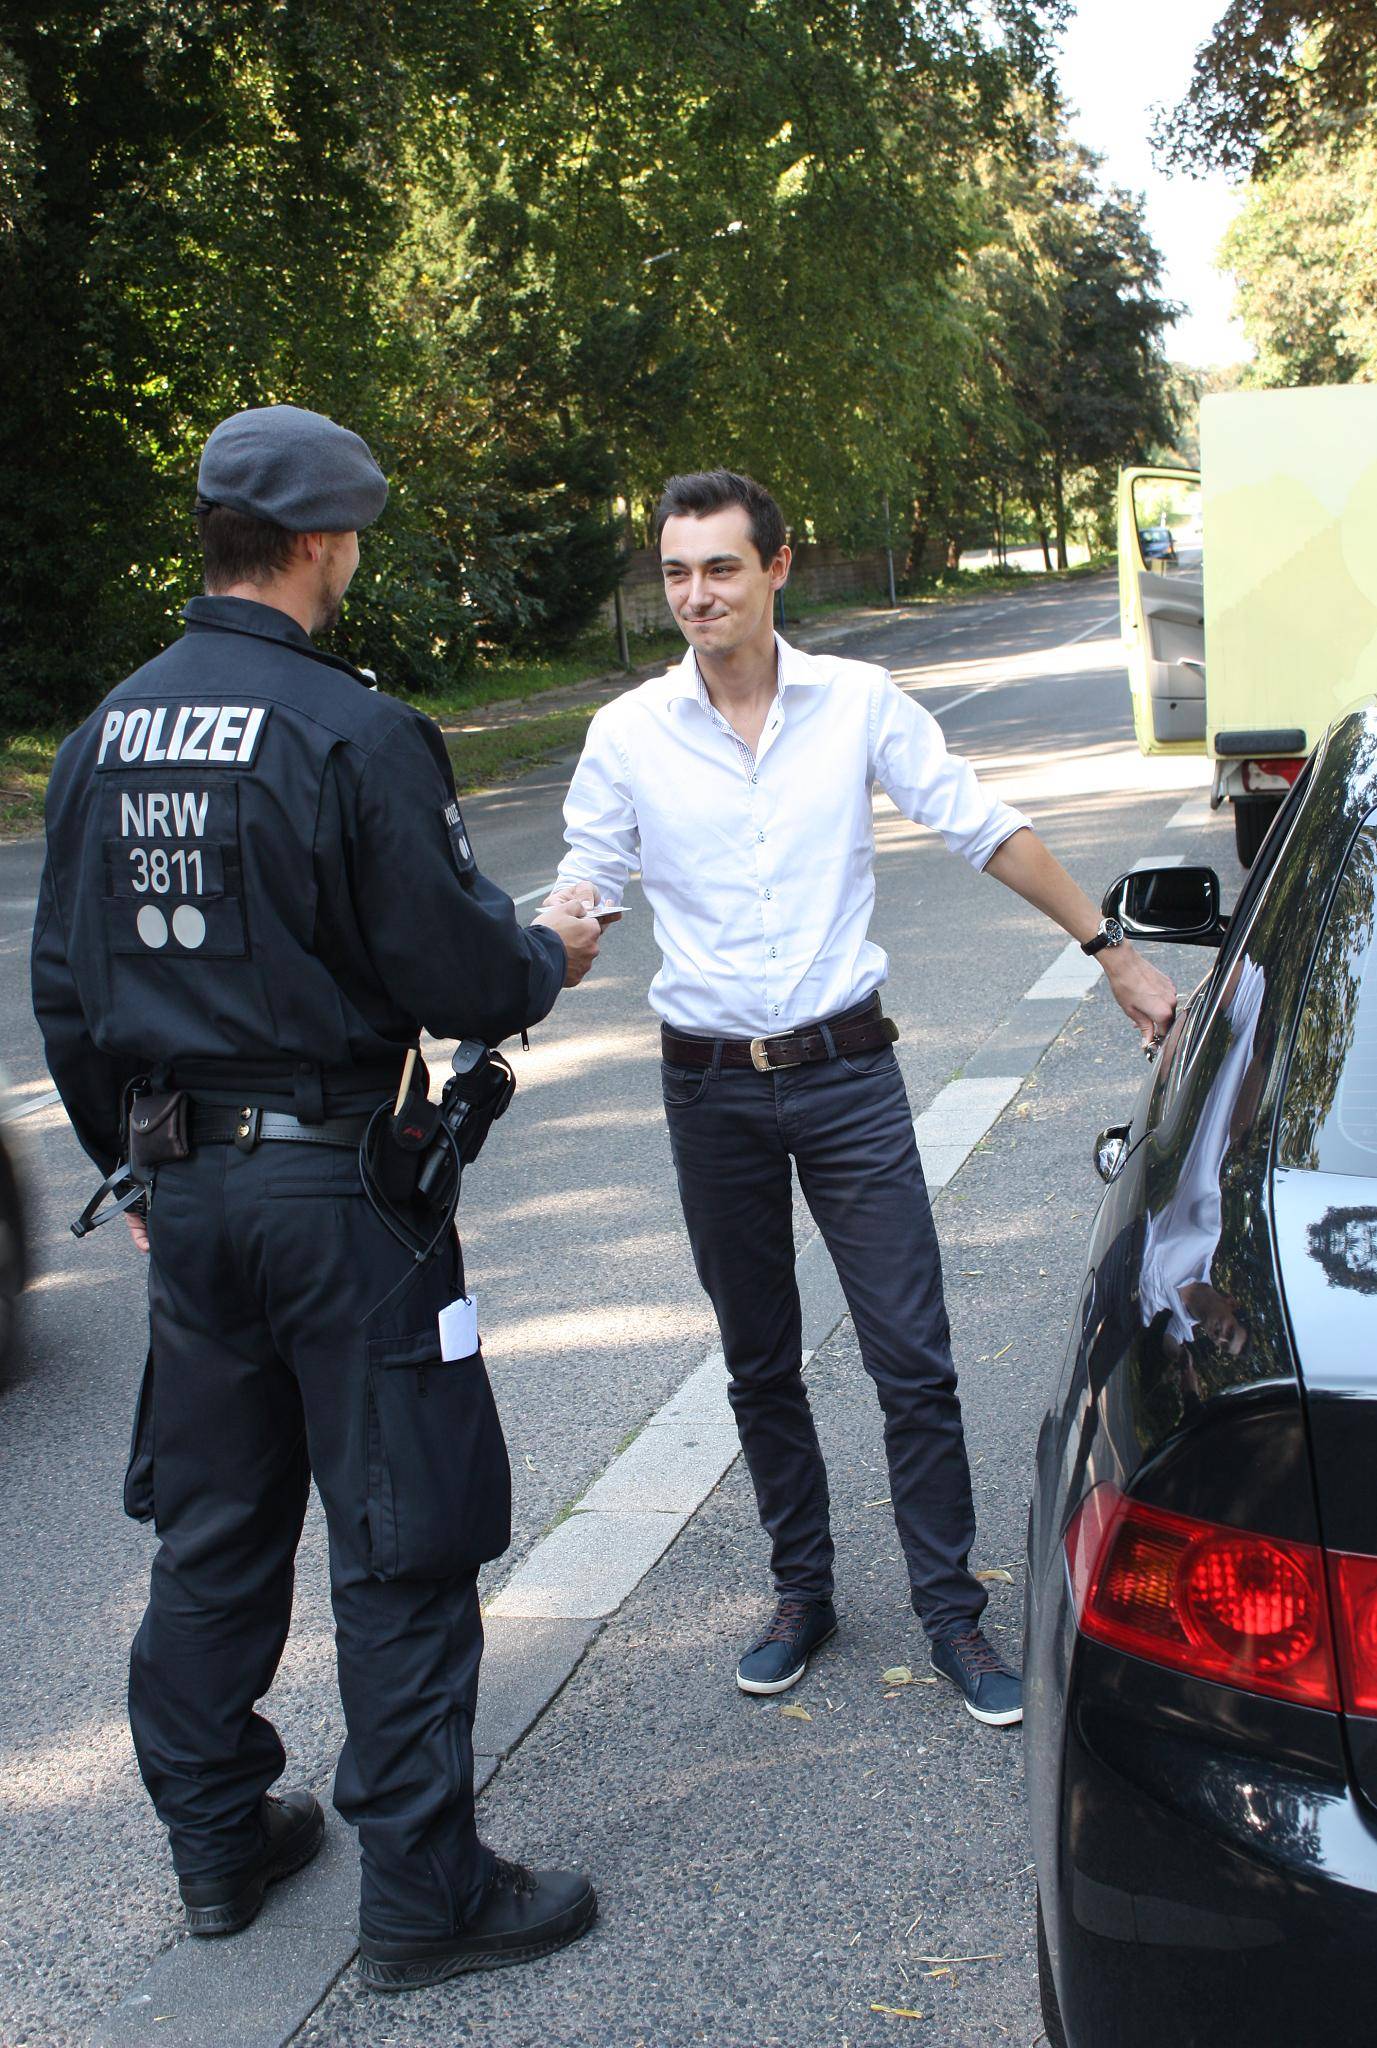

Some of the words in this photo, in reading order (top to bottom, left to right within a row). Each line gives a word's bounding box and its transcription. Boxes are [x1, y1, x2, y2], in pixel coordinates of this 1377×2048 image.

[97, 707, 265, 765] POLIZEI
[121, 792, 208, 837] NRW
[130, 848, 204, 895] 3811
